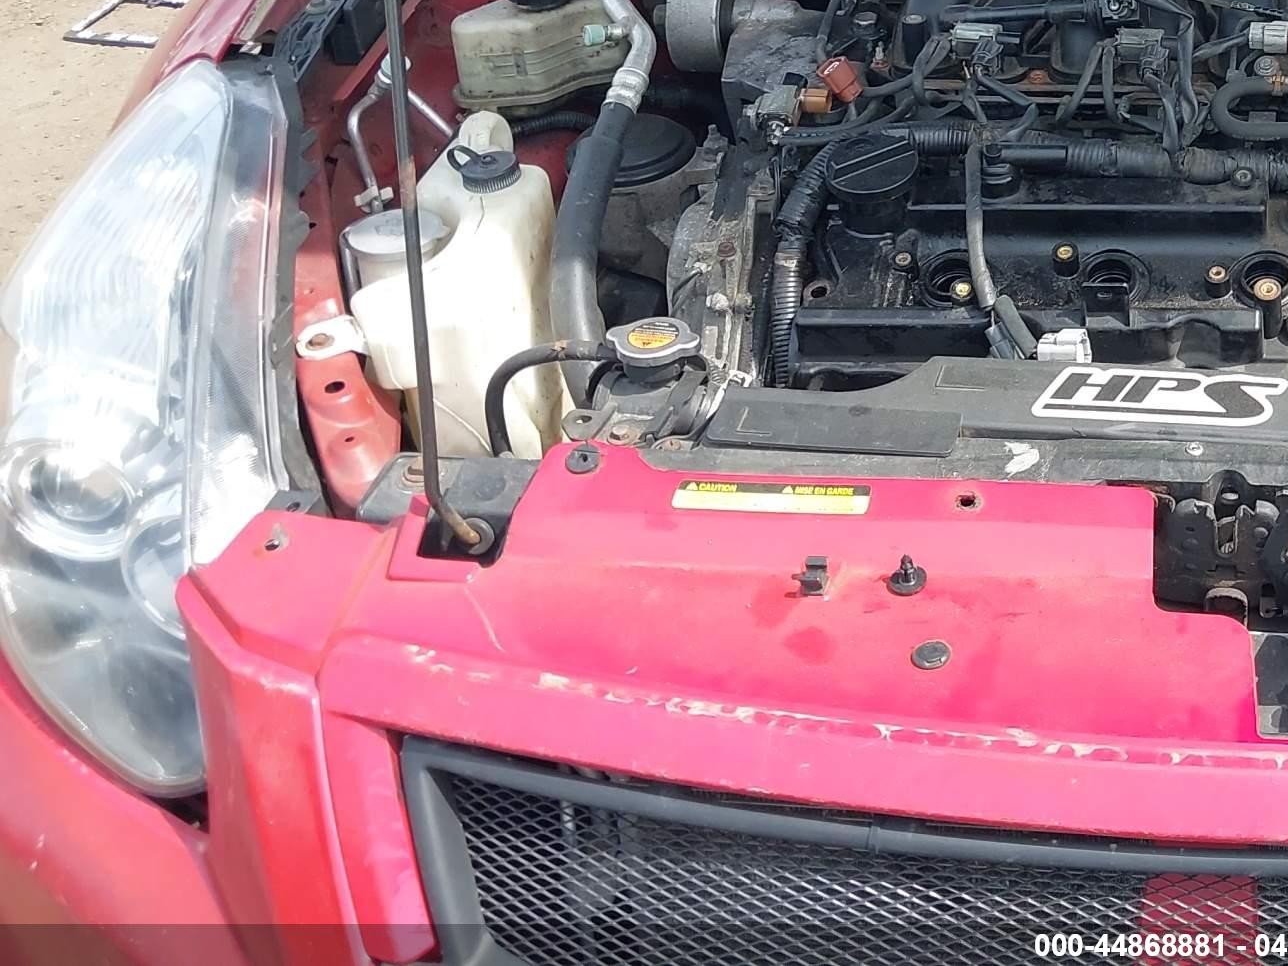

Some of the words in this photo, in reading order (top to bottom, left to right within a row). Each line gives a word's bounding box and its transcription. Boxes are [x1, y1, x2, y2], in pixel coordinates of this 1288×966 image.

[1036, 369, 1285, 424] HPS
[699, 484, 738, 493] CAUTION
[794, 486, 813, 495] MISE
[814, 487, 826, 495] EN
[826, 487, 854, 496] GARDE
